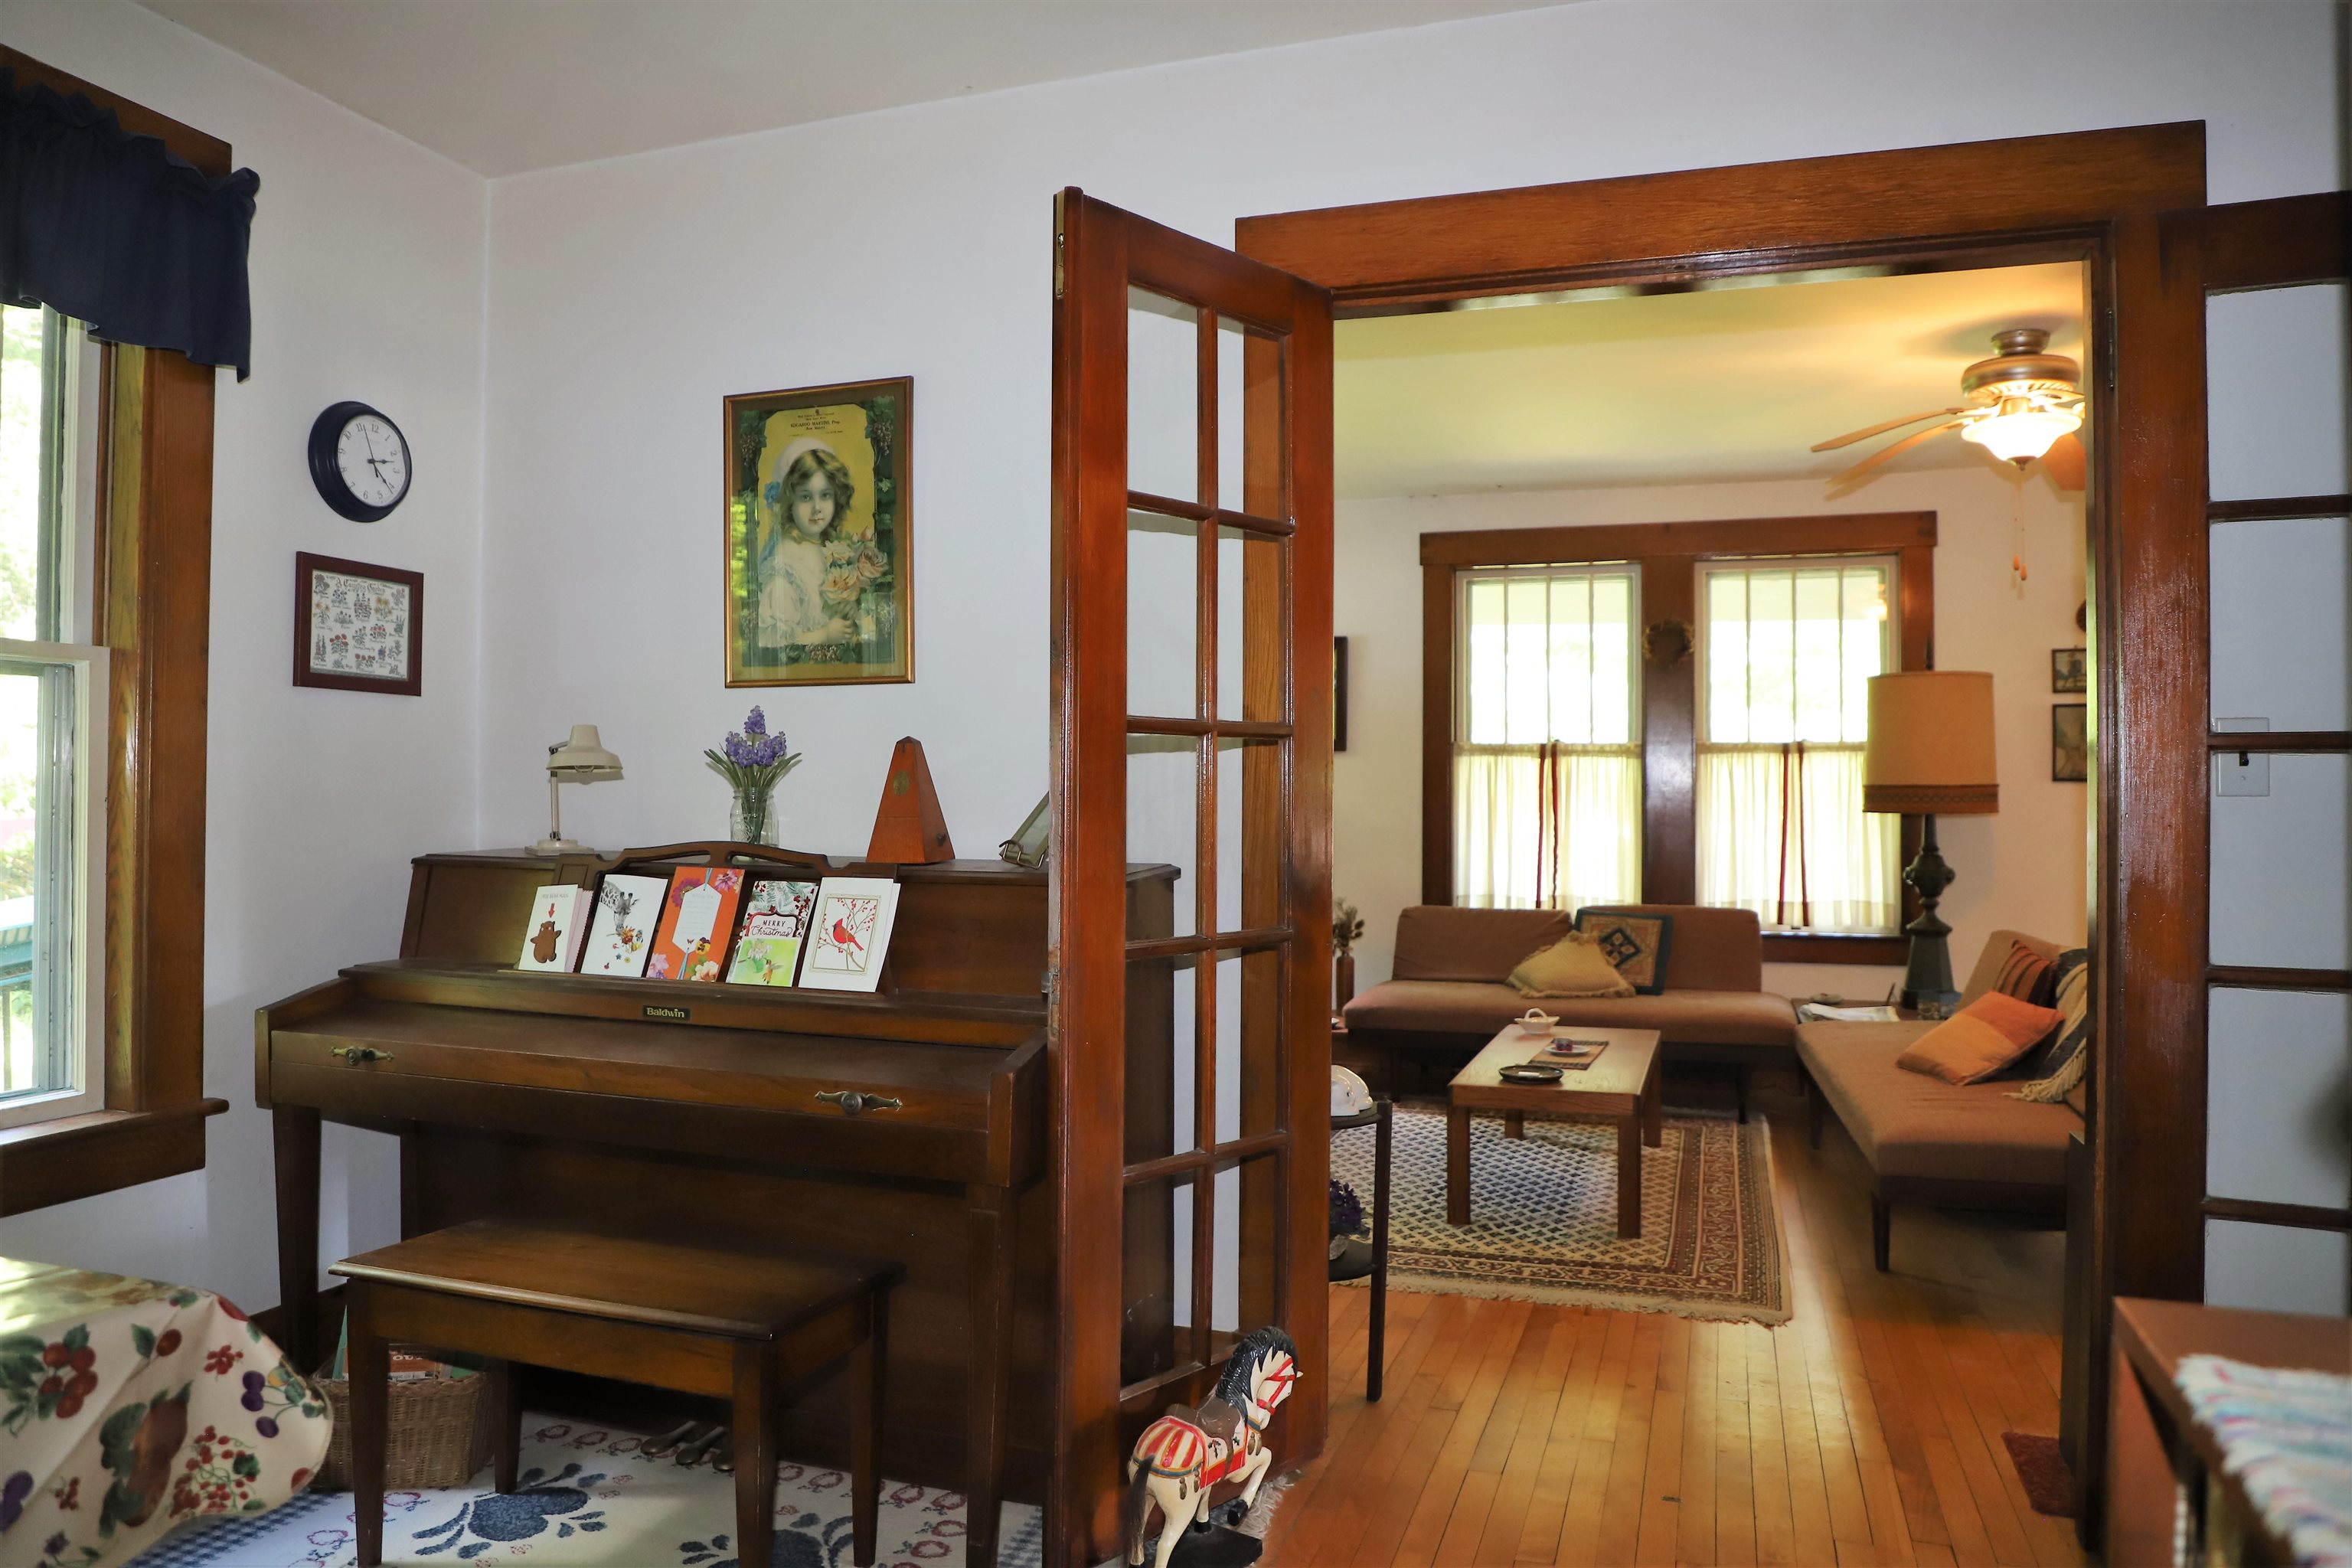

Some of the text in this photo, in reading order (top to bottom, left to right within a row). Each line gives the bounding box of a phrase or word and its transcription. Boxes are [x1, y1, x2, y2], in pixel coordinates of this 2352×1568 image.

[356, 423, 363, 432] 11
[371, 423, 378, 433] 12
[344, 430, 351, 440] 10
[363, 491, 369, 500] 6
[377, 491, 383, 500] 5
[751, 925, 793, 937] Christmas
[646, 1007, 684, 1018] Baldwin
